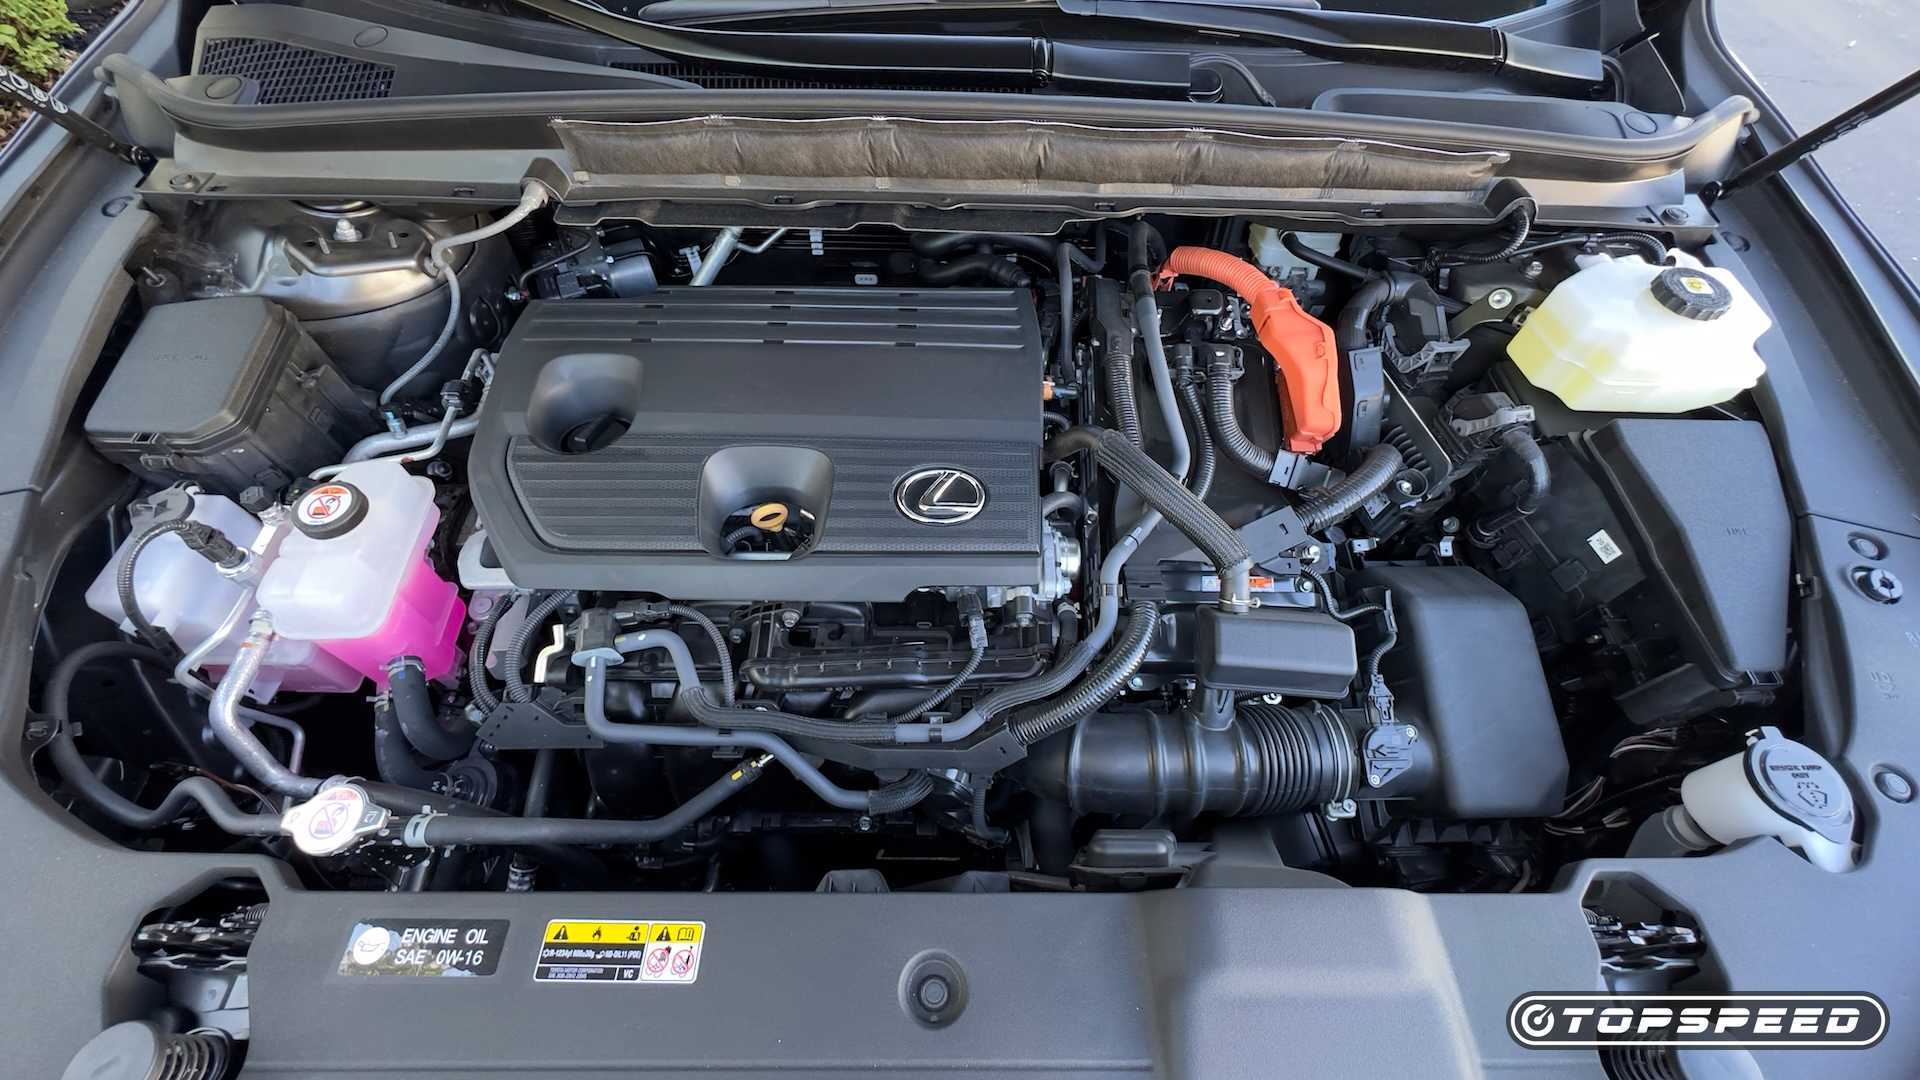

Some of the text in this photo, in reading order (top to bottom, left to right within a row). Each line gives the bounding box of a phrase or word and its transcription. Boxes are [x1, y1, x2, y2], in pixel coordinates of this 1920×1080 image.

[400, 928, 489, 944] ENGINE OIL
[394, 949, 484, 966] SAE 0W-16
[623, 969, 634, 979] VC
